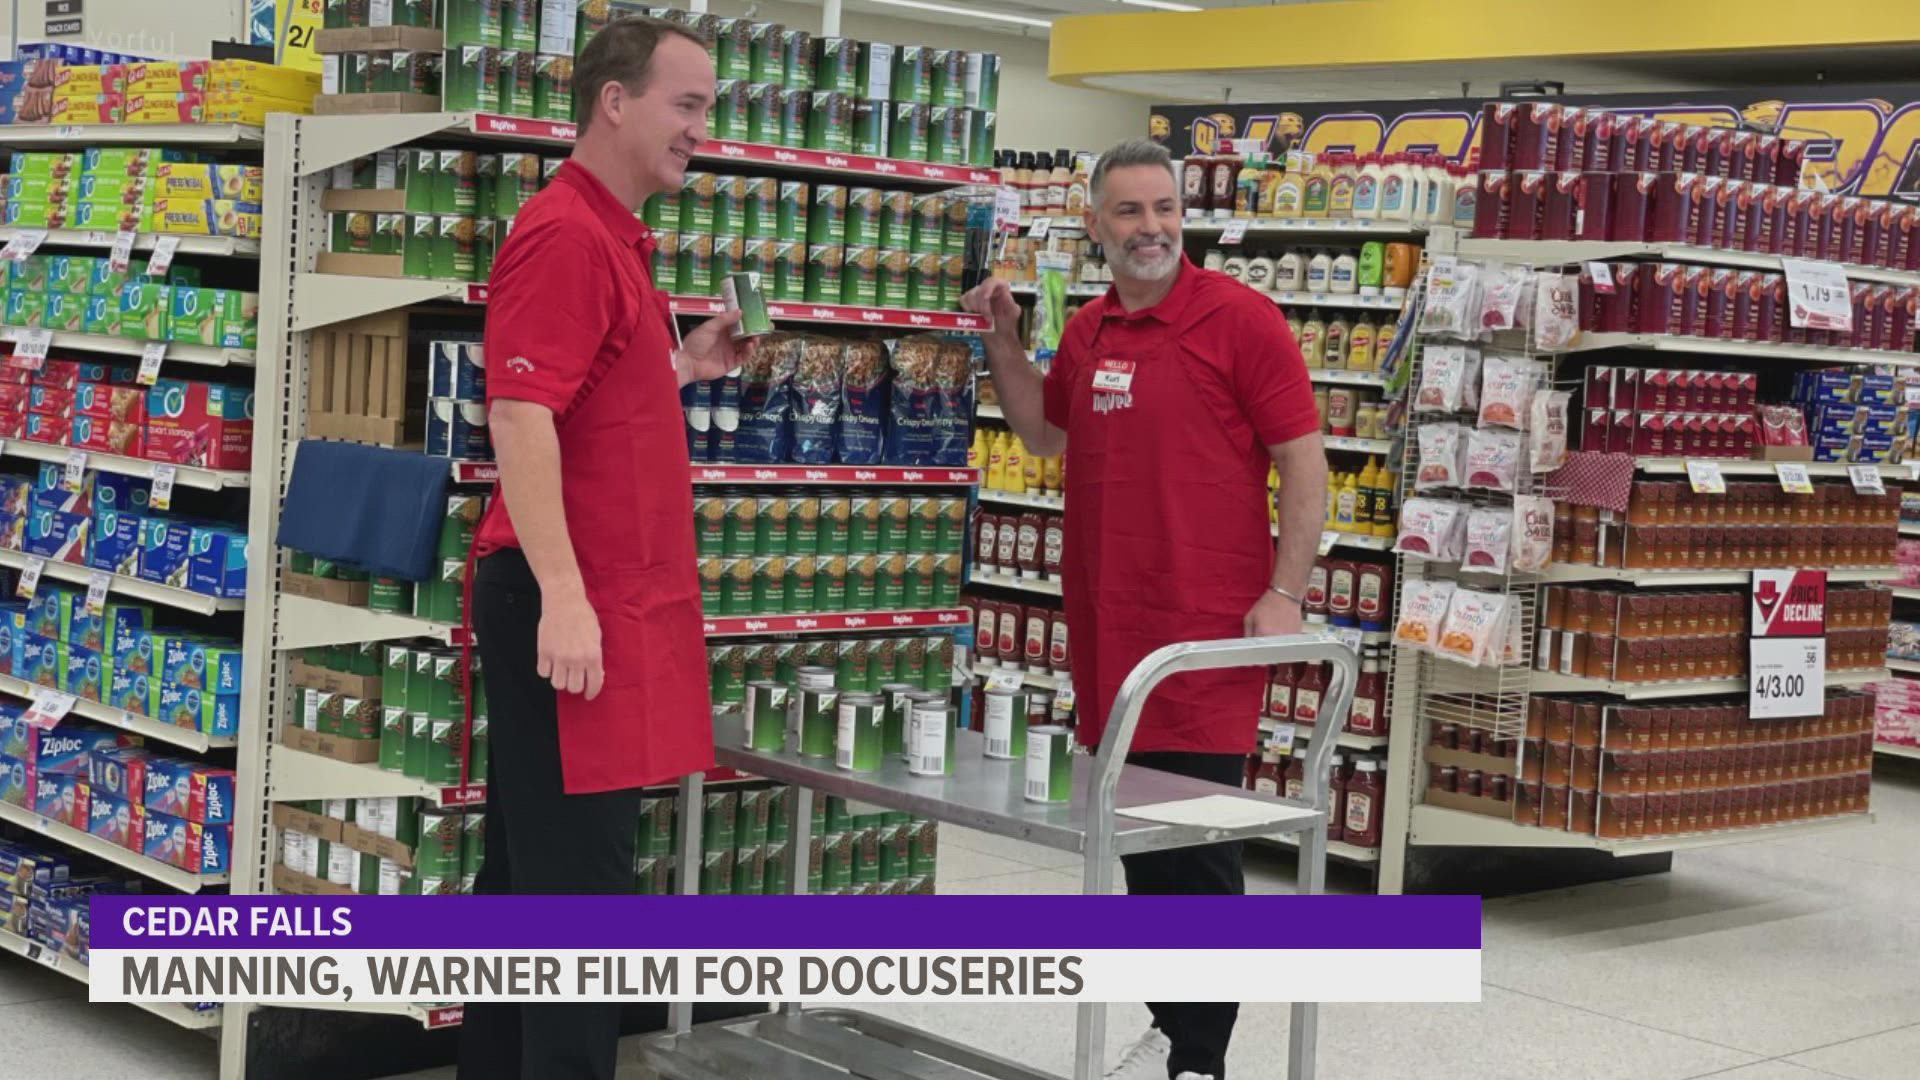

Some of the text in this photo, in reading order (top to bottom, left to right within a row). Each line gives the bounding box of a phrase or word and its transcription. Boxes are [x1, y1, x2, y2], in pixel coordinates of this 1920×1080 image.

[897, 416, 920, 429] Crispy
[1791, 585, 1818, 602] PRICE
[1783, 604, 1824, 621] DECLINE
[221, 661, 232, 688] Ziploc
[1755, 674, 1805, 699] 4/3.00
[217, 703, 228, 729] Ziploc
[41, 737, 83, 757] Ziploc
[37, 780, 58, 799] Ziploc
[147, 772, 170, 792] Ziploc
[92, 799, 113, 819] Ziploc
[207, 783, 222, 818] Ziploc
[146, 820, 168, 840] Ziploc
[202, 833, 218, 868] Ziploc
